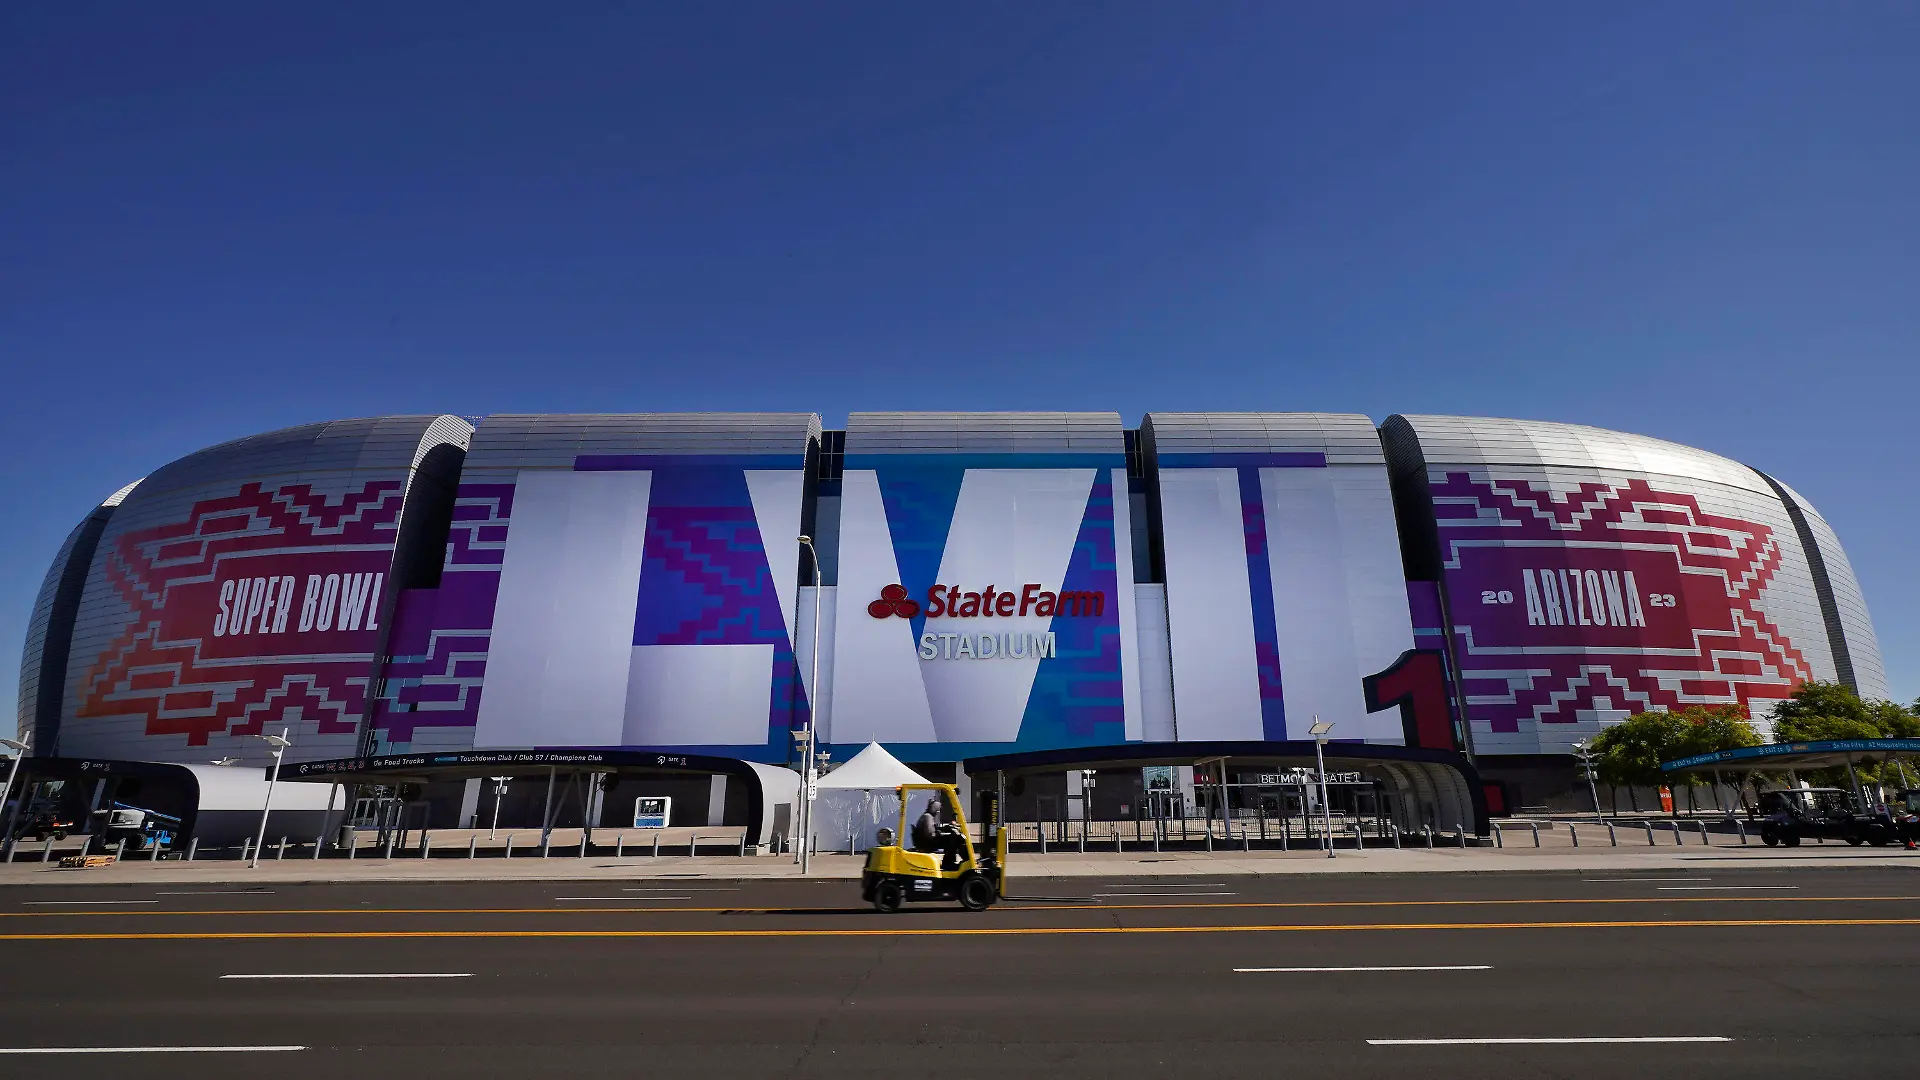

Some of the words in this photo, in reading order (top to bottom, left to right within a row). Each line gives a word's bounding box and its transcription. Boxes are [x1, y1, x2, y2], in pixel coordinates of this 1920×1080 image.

[213, 575, 296, 637] SUPER
[298, 572, 384, 633] BOWL
[924, 584, 1015, 618] State
[1018, 583, 1105, 617] Farm
[1481, 590, 1514, 604] 20
[1522, 568, 1646, 627] ARIZONA
[1649, 593, 1676, 608] 23
[918, 631, 1056, 660] STADIUM
[1362, 649, 1460, 751] 1
[384, 758, 401, 766] Food
[402, 757, 425, 765] Trucks
[550, 754, 587, 762] Champions
